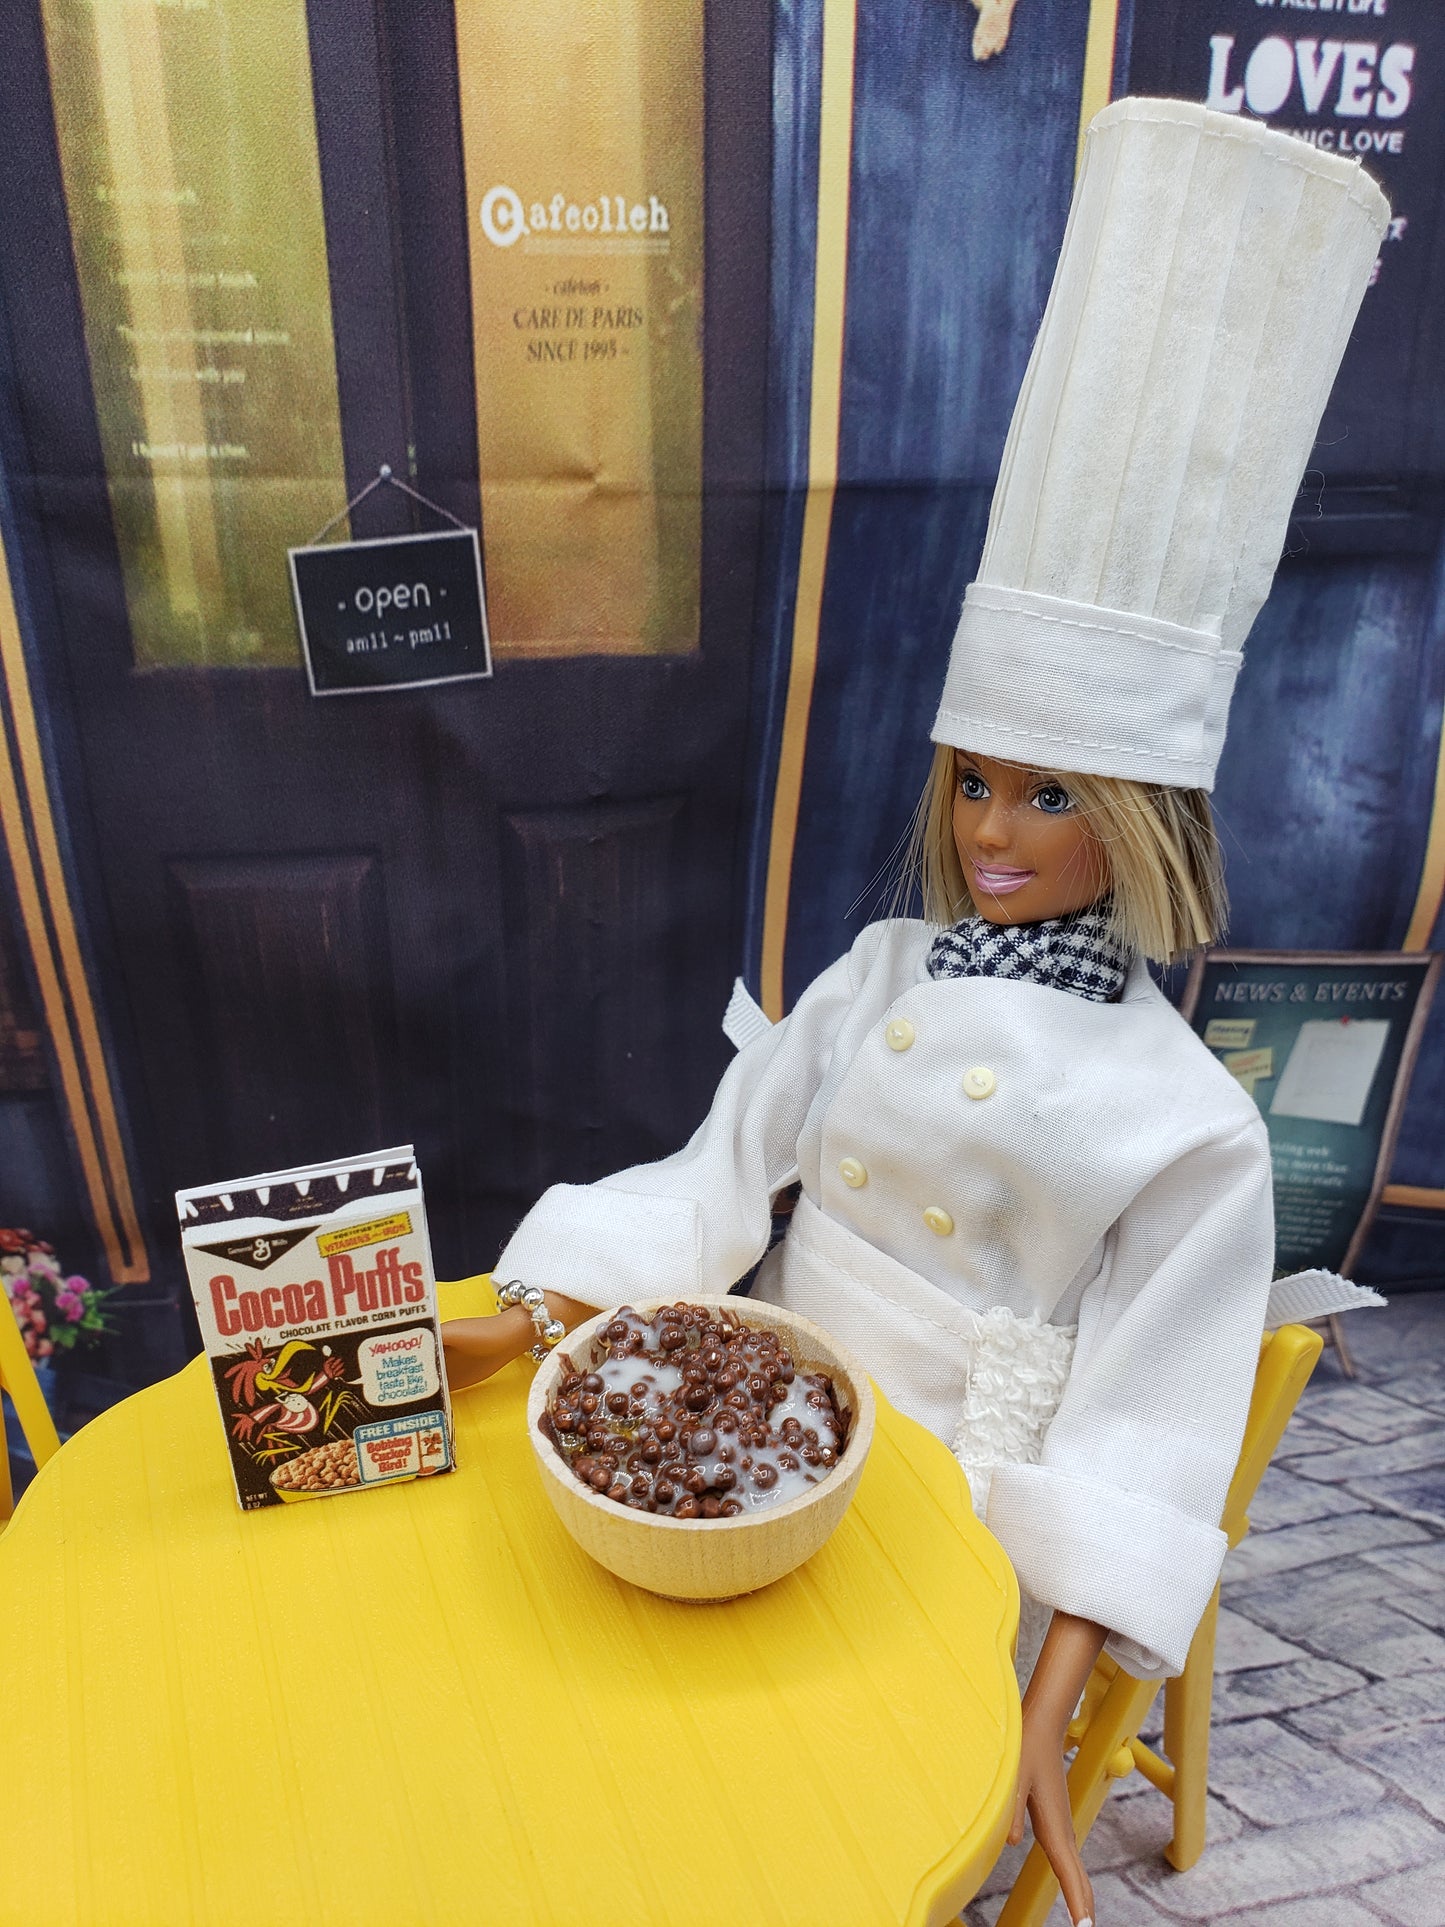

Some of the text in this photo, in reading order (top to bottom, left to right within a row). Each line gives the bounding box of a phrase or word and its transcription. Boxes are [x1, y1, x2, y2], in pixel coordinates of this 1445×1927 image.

[1207, 34, 1415, 119] LOVES
[1338, 129, 1404, 153] LOVE
[355, 583, 431, 618] open
[1215, 982, 1410, 1002] NEWS & EVENTS
[209, 1247, 425, 1336] Cocoa Puffs
[280, 1304, 427, 1340] CHOCOLATE FLAVOR CORN PUFFS
[376, 1361, 424, 1381] breakfast
[382, 1354, 418, 1369] Makes
[378, 1380, 429, 1402] chocolate!
[379, 1374, 424, 1391] taste like
[359, 1414, 441, 1440] FREE INSIDE!
[378, 1457, 408, 1473] Bird!
